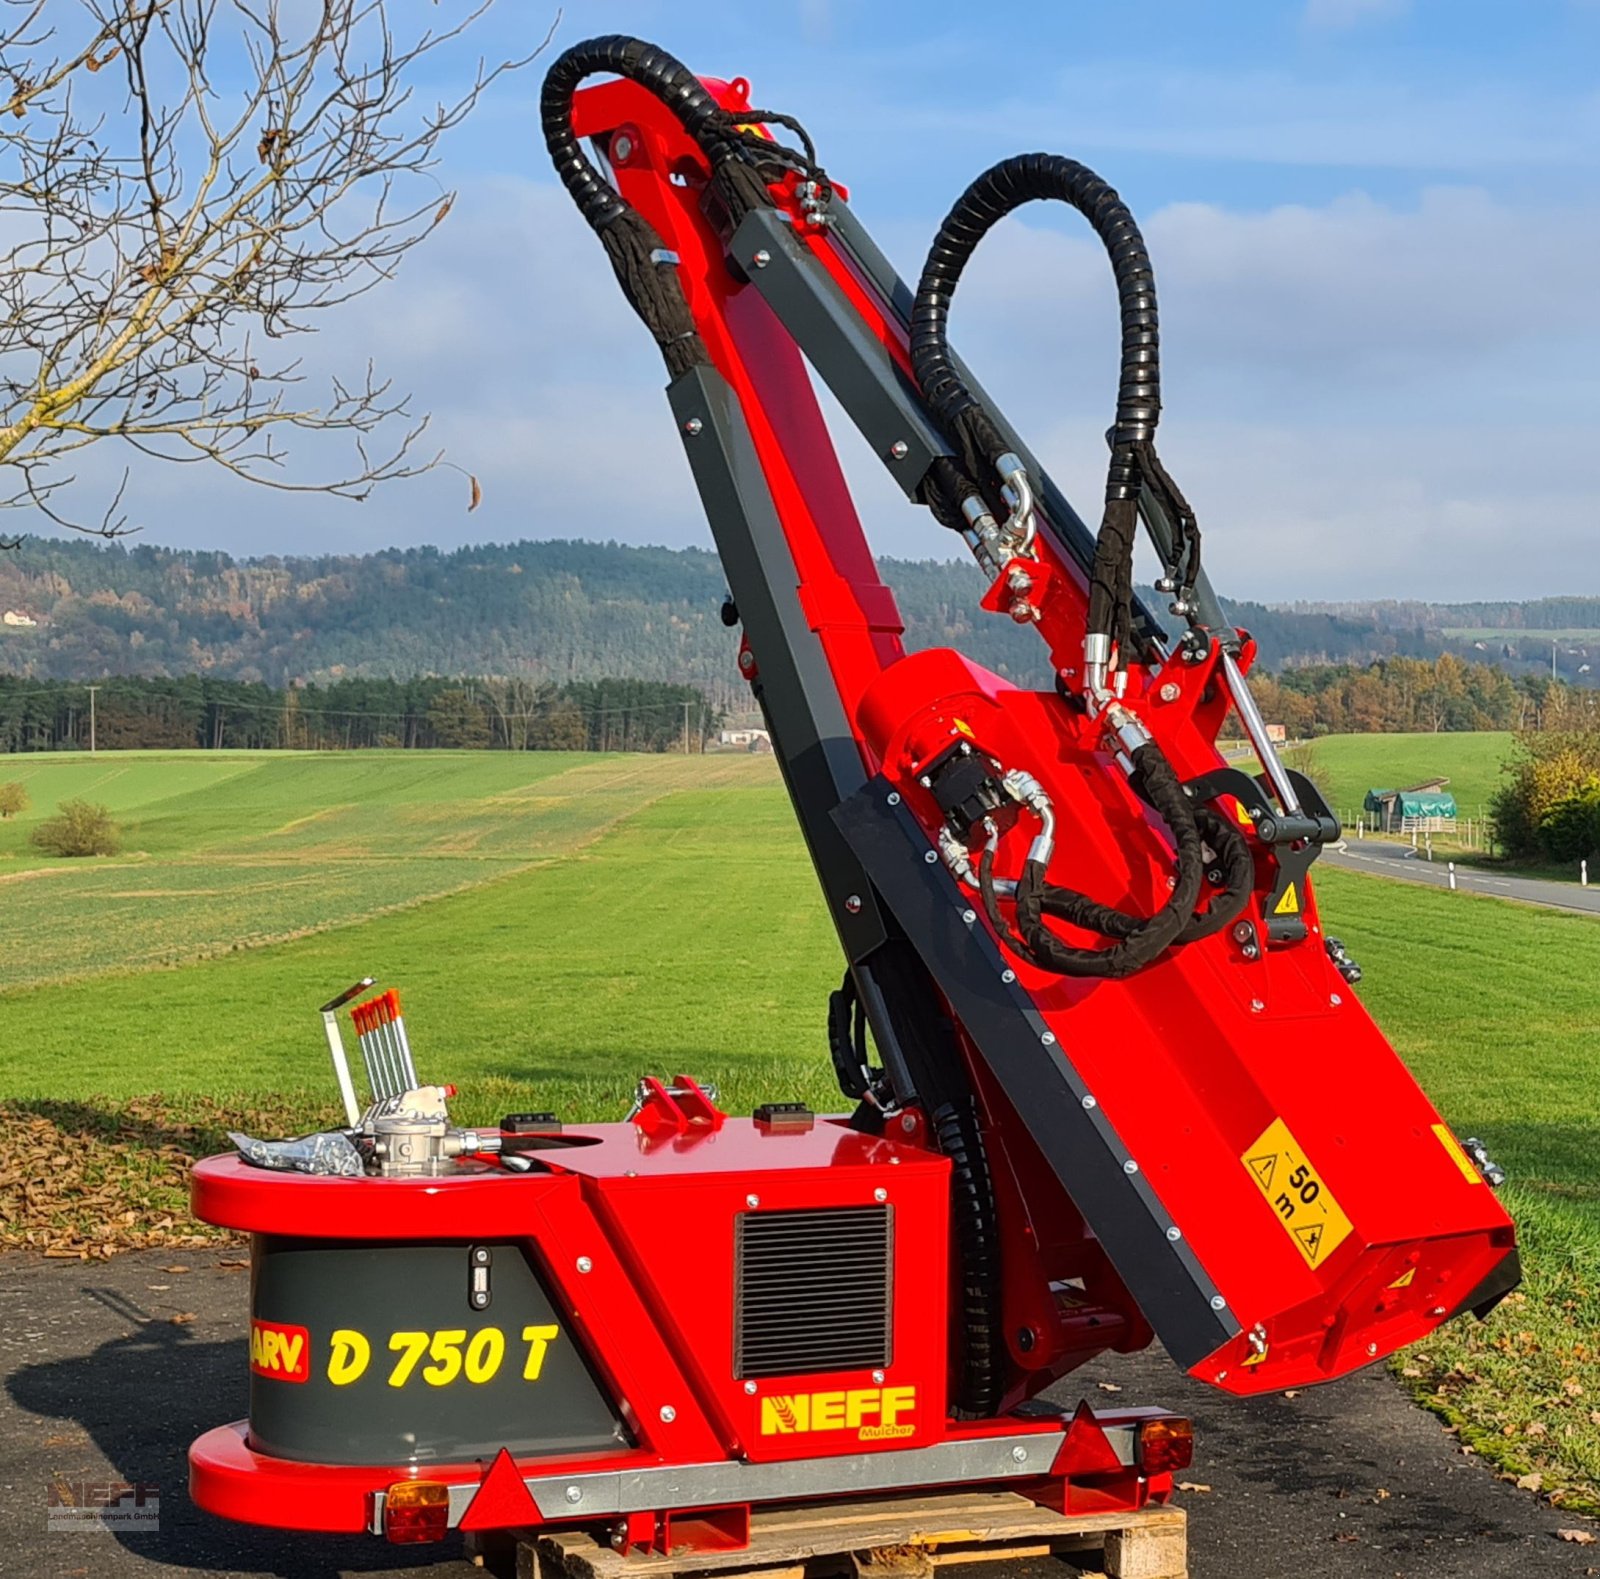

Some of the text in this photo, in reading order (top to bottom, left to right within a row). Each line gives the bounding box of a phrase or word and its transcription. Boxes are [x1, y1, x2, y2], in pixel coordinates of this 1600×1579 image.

[1275, 1192, 1295, 1220] m
[1289, 1165, 1319, 1204] 50
[327, 1324, 559, 1387] D 750 T
[761, 1386, 915, 1435] NEFF
